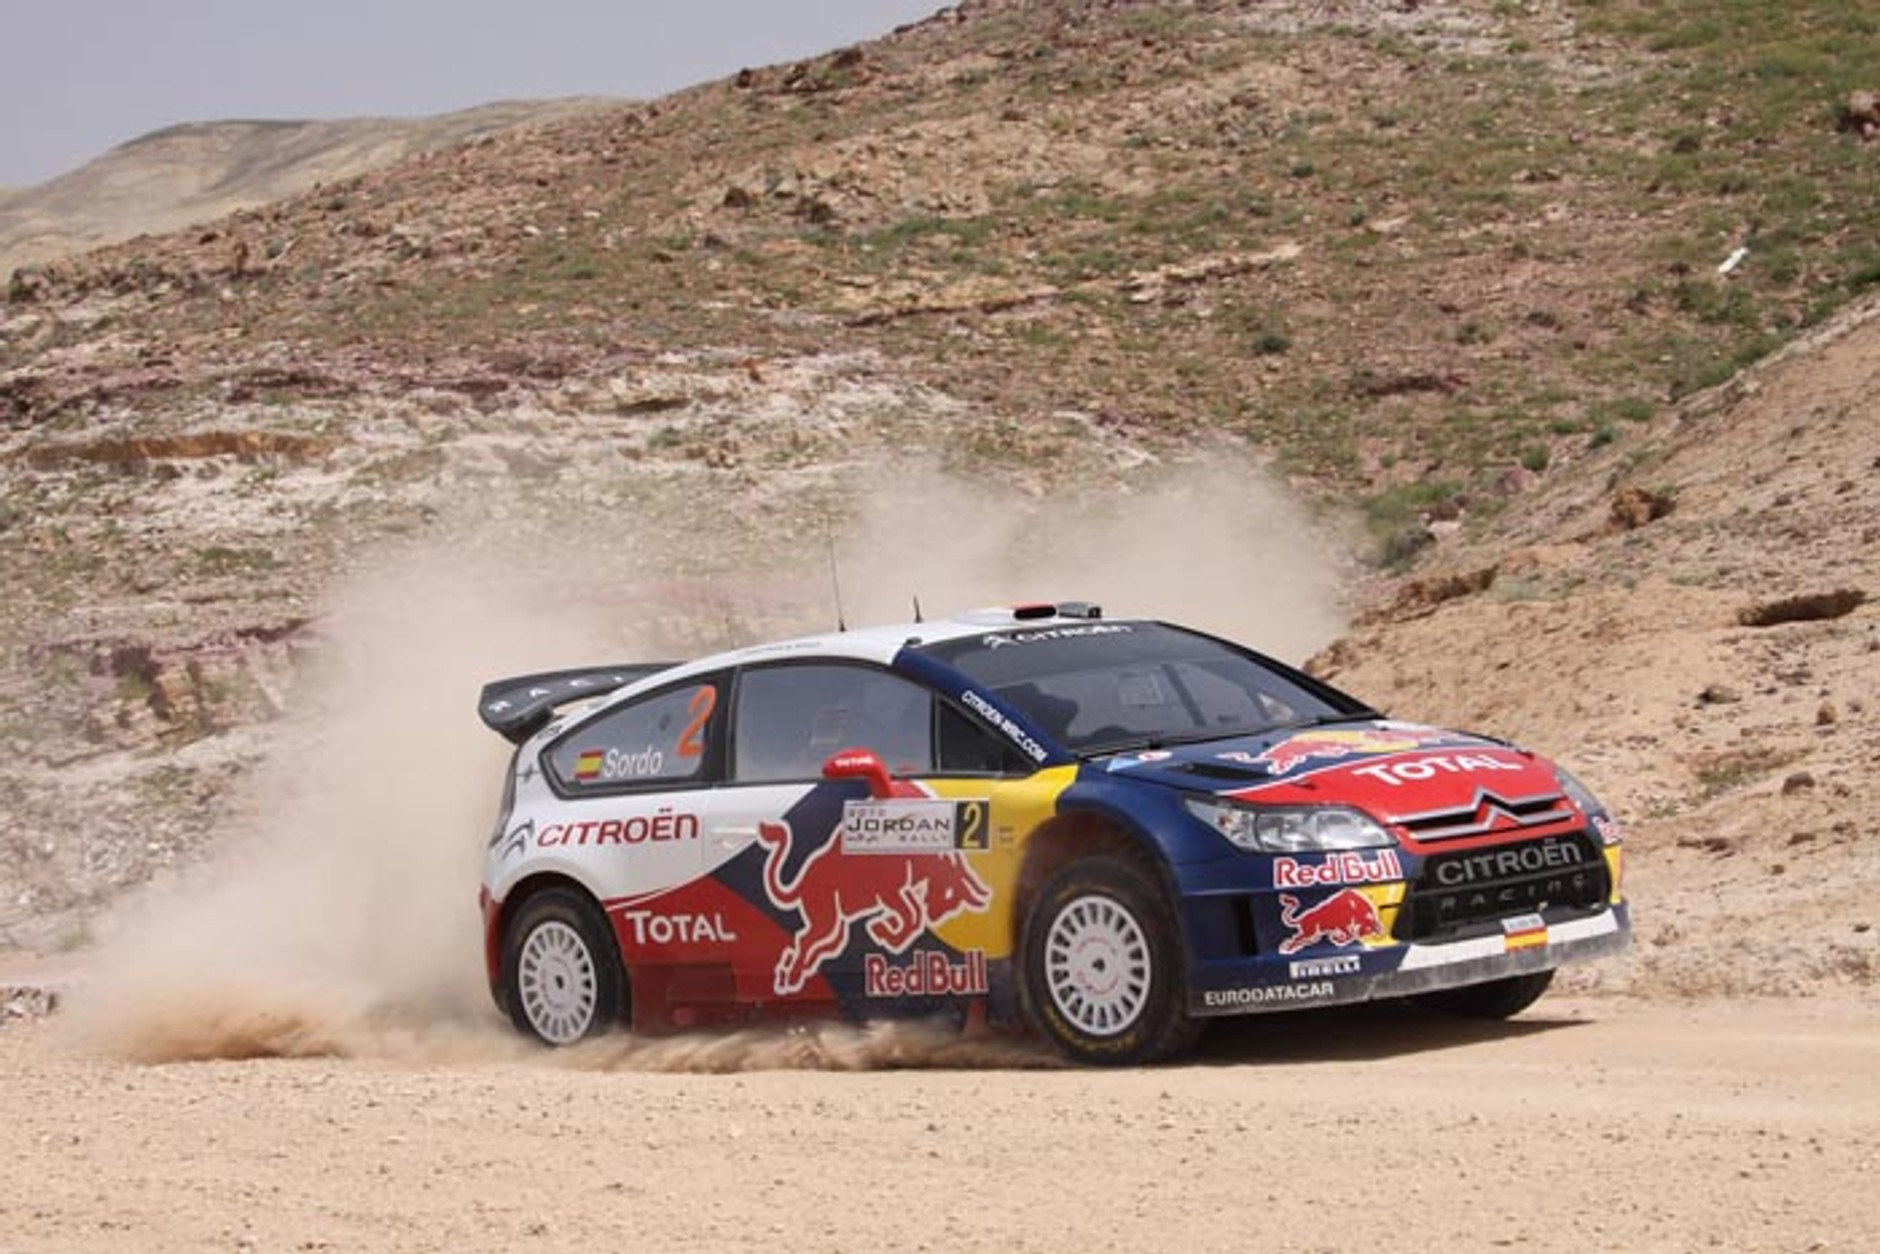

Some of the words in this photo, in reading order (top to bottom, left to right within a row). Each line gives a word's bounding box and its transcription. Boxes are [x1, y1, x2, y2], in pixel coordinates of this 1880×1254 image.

[675, 684, 716, 759] 2
[604, 747, 663, 778] Sordo
[1352, 752, 1523, 785] TOTAL
[847, 816, 950, 834] JORDAN
[961, 801, 983, 848] 2
[1273, 852, 1341, 889] Red
[1341, 848, 1404, 882] Bull
[624, 910, 737, 945] TOTAL
[864, 950, 925, 998] Red
[926, 948, 989, 995] Bull
[1204, 982, 1334, 1007] EURODATACAR
